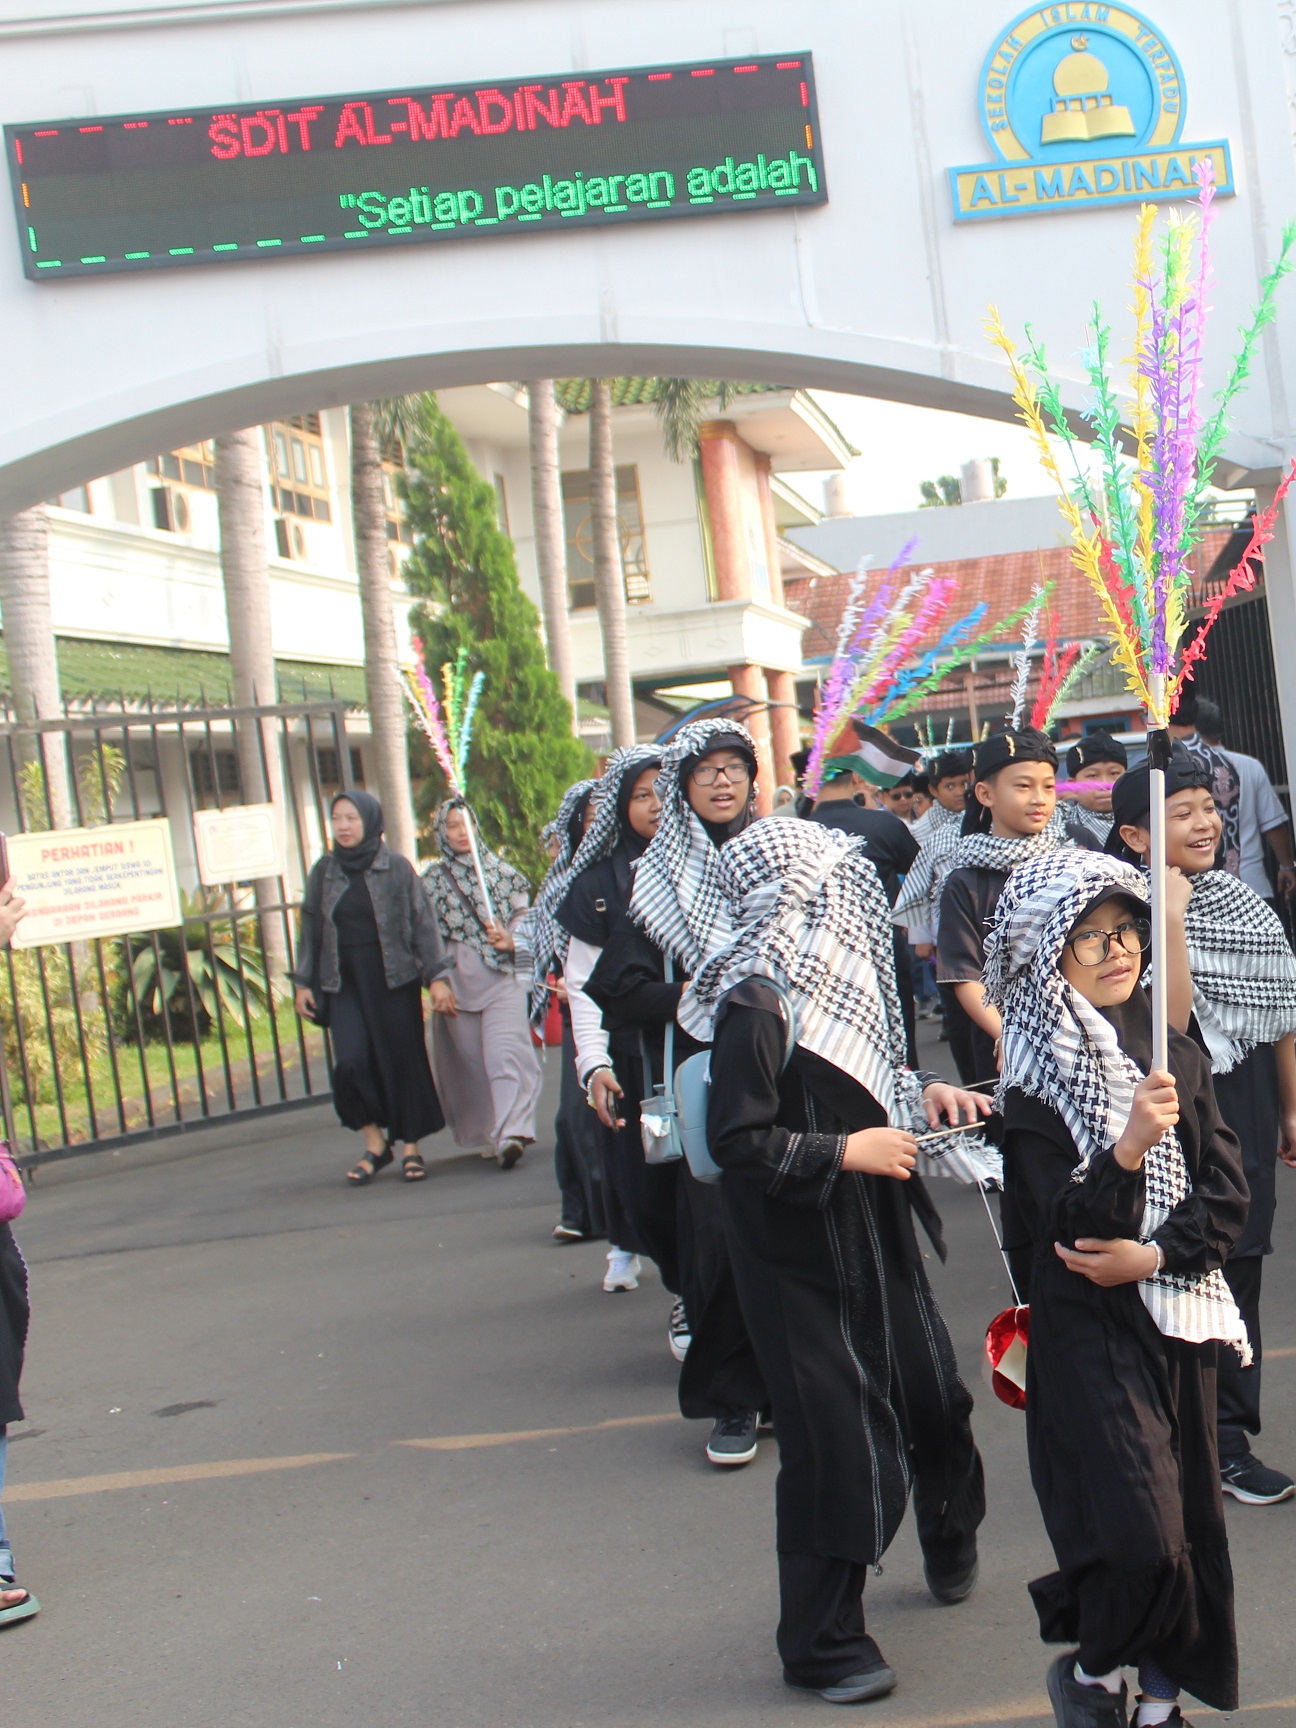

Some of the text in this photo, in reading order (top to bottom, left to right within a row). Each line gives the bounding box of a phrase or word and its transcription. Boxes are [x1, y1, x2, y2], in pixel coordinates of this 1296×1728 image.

[1041, 4, 1112, 26] ISLAM
[989, 34, 1024, 132] SEKOLAH
[1134, 24, 1180, 113] TERPADU
[208, 79, 629, 160] SDIT AL-MADINAH
[495, 171, 675, 222] pelajaran
[687, 150, 817, 197] adalah
[40, 841, 125, 863] PERHATIAN
